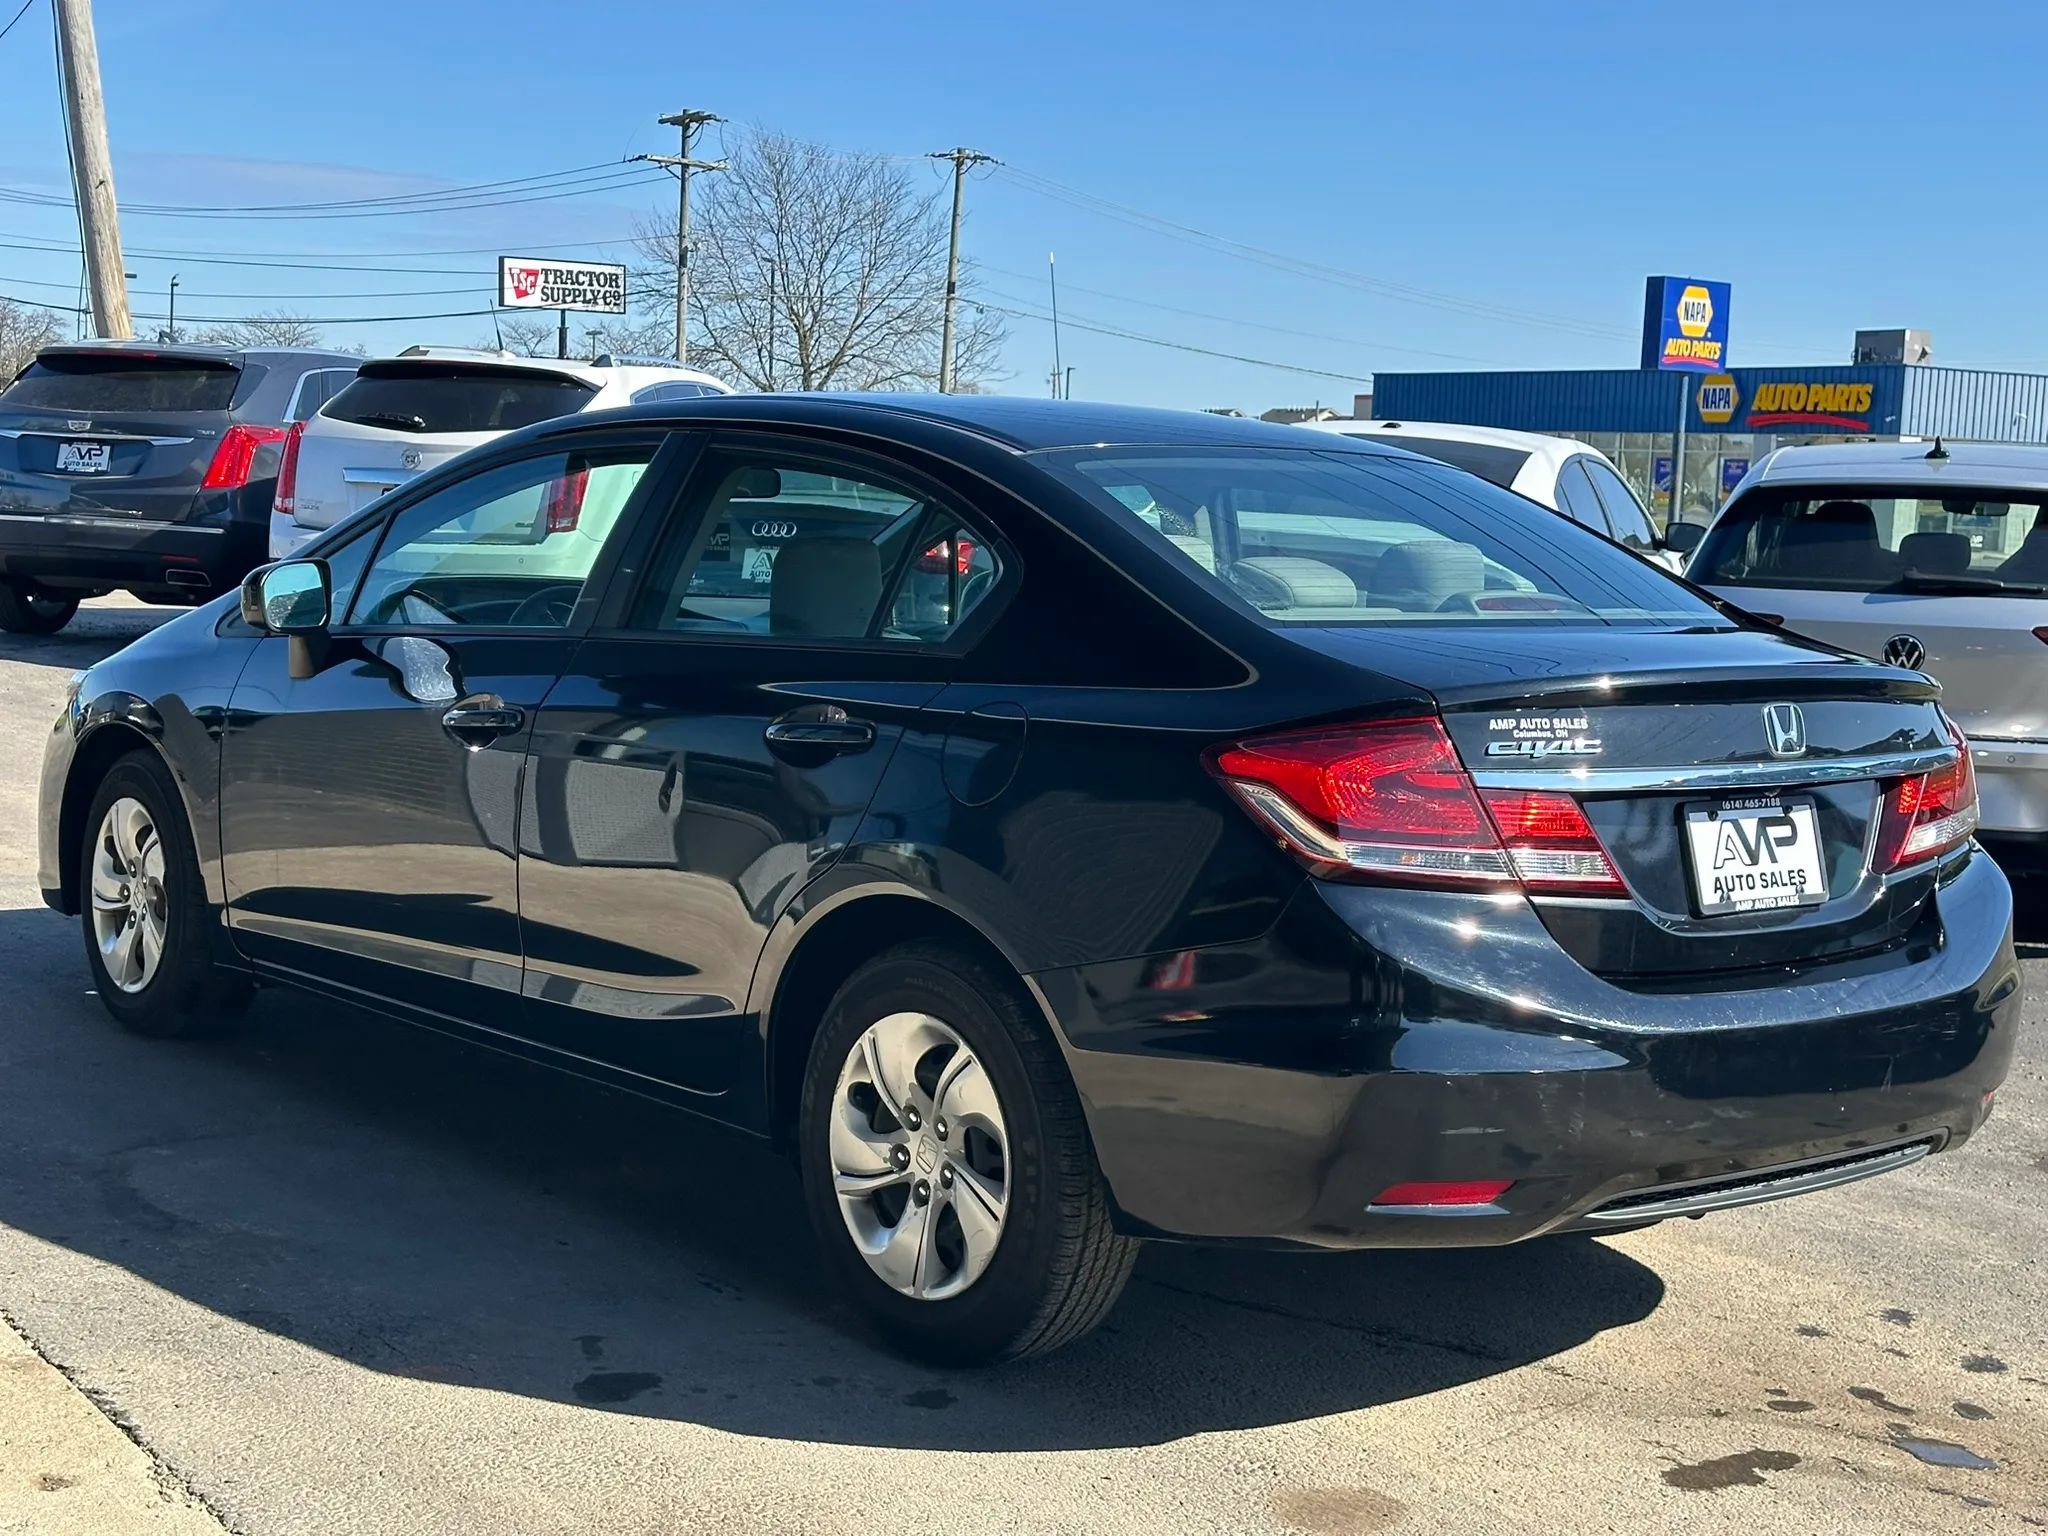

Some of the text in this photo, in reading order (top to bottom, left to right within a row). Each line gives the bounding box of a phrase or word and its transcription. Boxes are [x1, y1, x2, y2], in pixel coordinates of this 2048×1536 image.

[511, 268, 536, 295] TSC
[541, 268, 621, 289] TRACTOR
[540, 285, 601, 305] SUPPLY
[1683, 301, 1707, 323] NAPA
[1665, 338, 1722, 360] AUTO PARTS
[1702, 388, 1731, 410] NAPA
[1751, 383, 1873, 413] AUTO PARTS
[749, 570, 771, 578] AUTO
[1489, 718, 1588, 730] AMP AUTO SALES
[1513, 729, 1569, 739] Columbus, OH
[1722, 799, 1743, 810] (614)
[1714, 869, 1807, 894] AUTO SALES
[1736, 895, 1800, 911] AMP AUTO SALES
